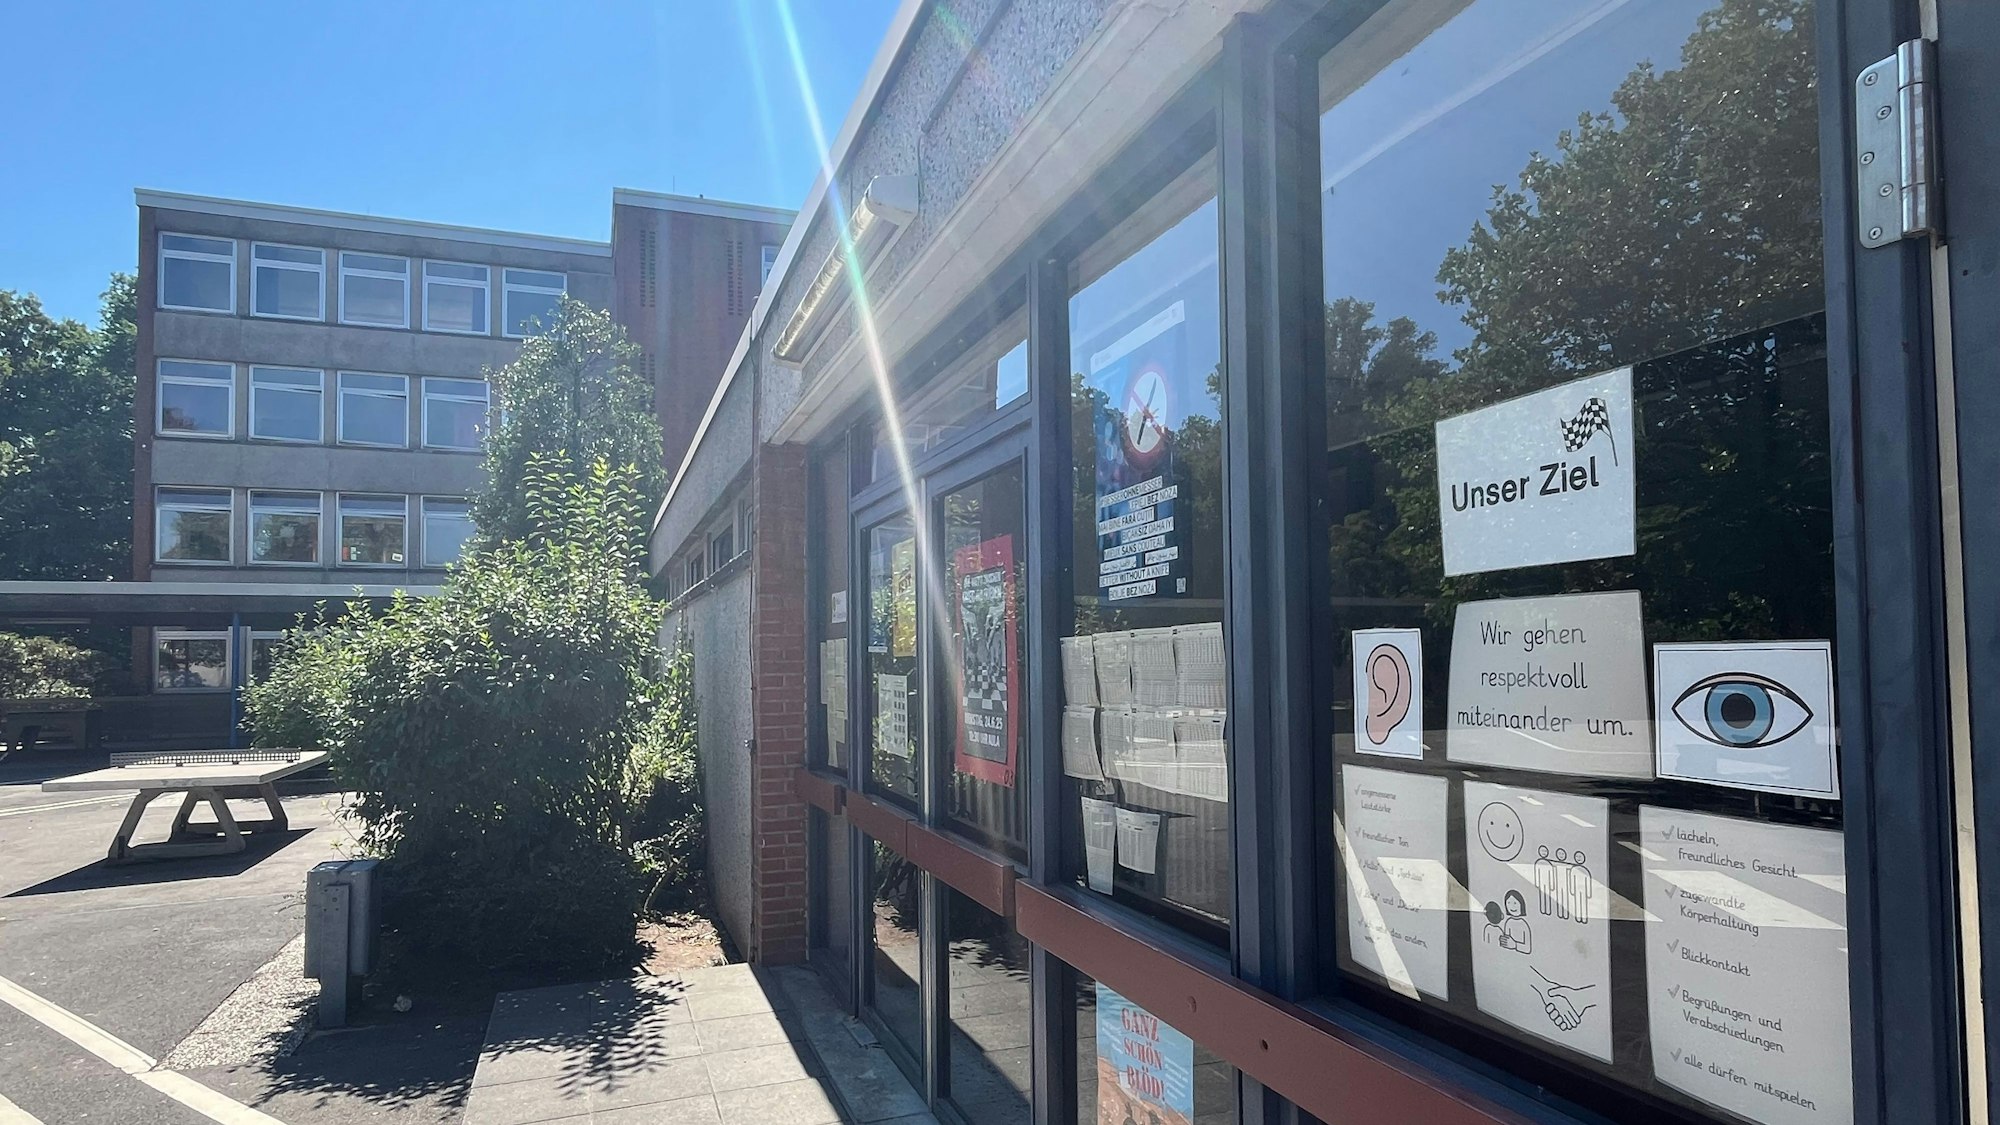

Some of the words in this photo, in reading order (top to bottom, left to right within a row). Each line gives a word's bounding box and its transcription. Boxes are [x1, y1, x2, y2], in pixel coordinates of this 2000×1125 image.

[1147, 493, 1158, 505] BEZ
[1452, 475, 1530, 512] Unser
[1539, 456, 1600, 496] Ziel
[1121, 543, 1137, 555] SANS
[1119, 569, 1146, 582] WITHOUT
[1126, 586, 1138, 597] BEZ
[1480, 620, 1512, 645] Wir
[1523, 618, 1587, 652] gehen
[1480, 662, 1588, 693] respektvoll
[1457, 705, 1572, 732] miteinander
[1587, 718, 1633, 736] um.
[1398, 836, 1410, 848] Ton
[1676, 827, 1719, 847] lächeln,
[1678, 848, 1746, 870] freundliches
[1752, 859, 1799, 879] Gesicht
[1382, 896, 1394, 906] und
[1680, 905, 1759, 937] Körperhaltung
[1681, 946, 1751, 977] Blickkontakt
[1121, 1007, 1160, 1042] GANZ
[1682, 989, 1752, 1022] Begrüßungen
[1758, 1016, 1783, 1031] und
[1682, 1009, 1784, 1053] Verabschiedungen
[1123, 1037, 1162, 1071] SCHÖN
[1127, 1064, 1166, 1101] BLÖD!
[1684, 1054, 1703, 1070] alle
[1708, 1062, 1748, 1086] dürfen
[1754, 1080, 1816, 1111] mitspielen
